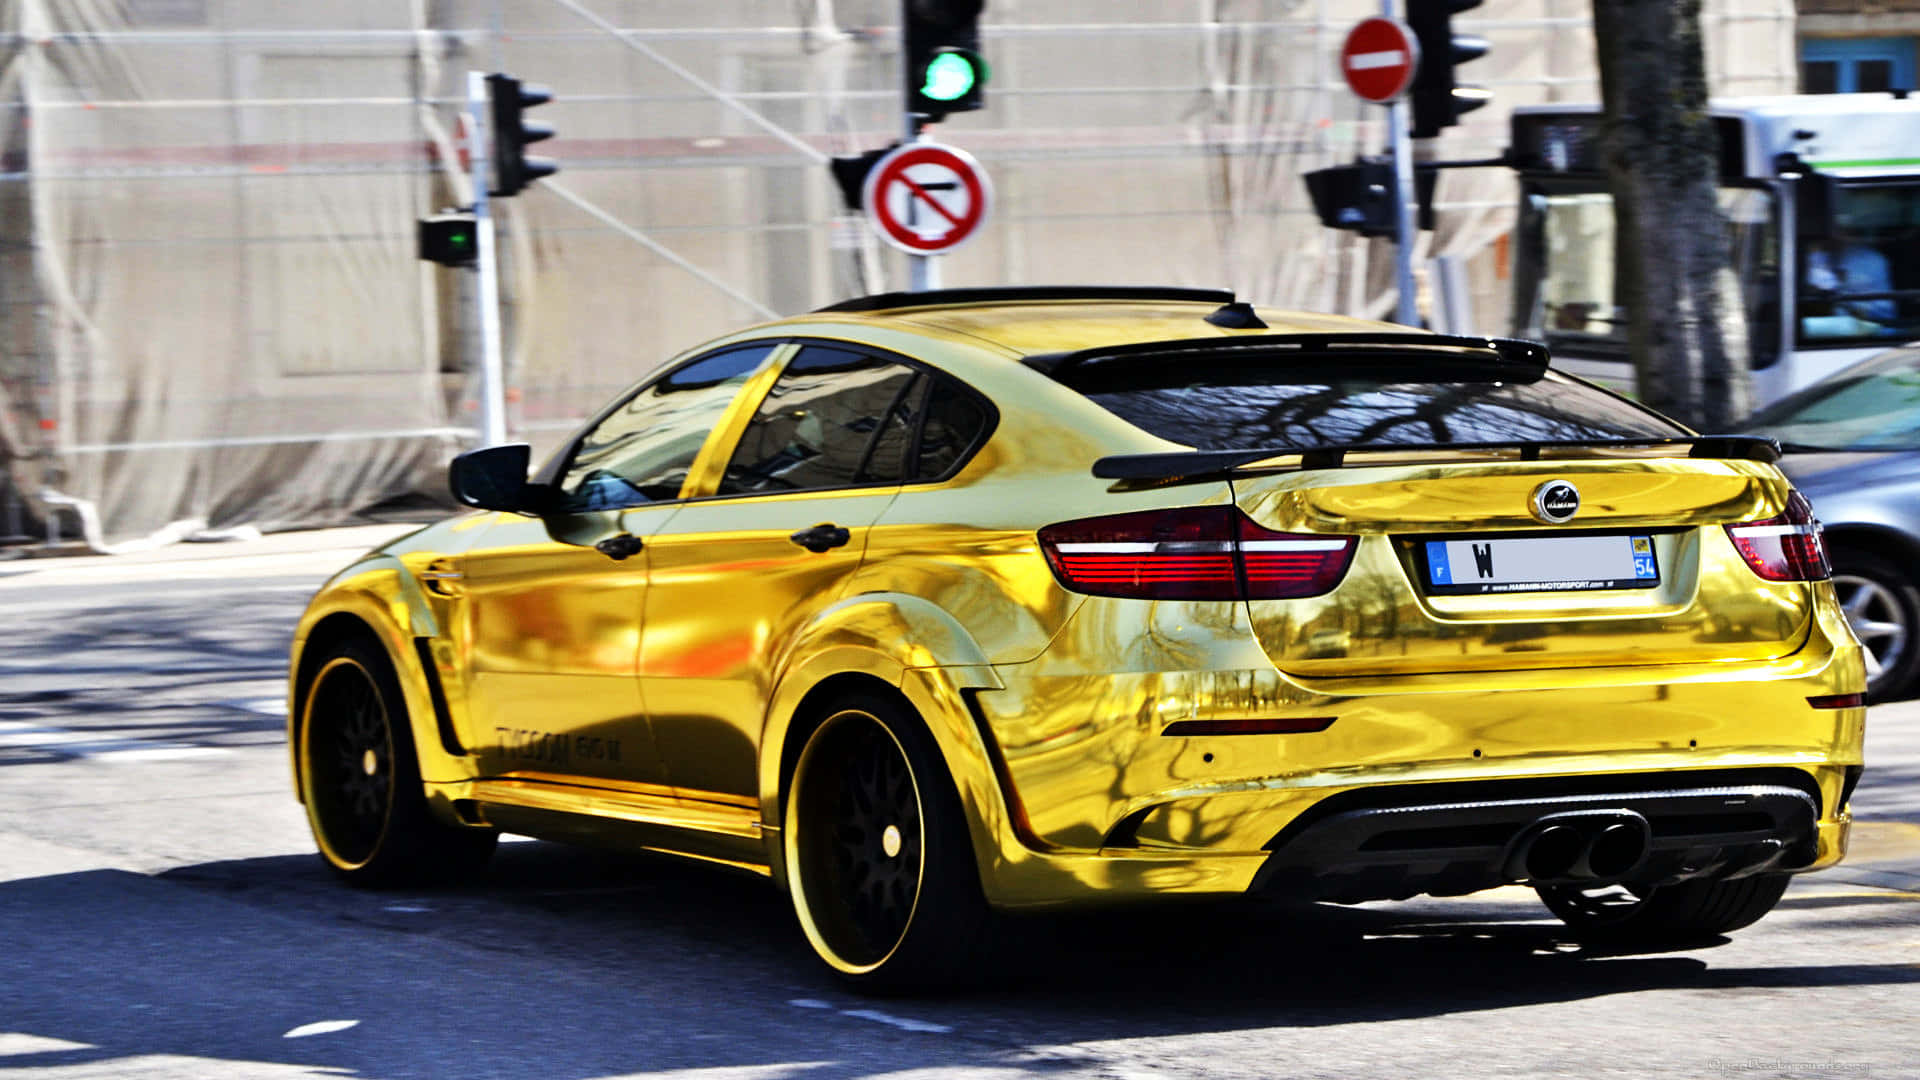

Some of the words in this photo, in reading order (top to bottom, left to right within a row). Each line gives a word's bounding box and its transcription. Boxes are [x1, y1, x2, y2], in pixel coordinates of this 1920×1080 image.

[1472, 543, 1494, 578] W
[1635, 558, 1655, 576] 54
[1436, 567, 1444, 578] F
